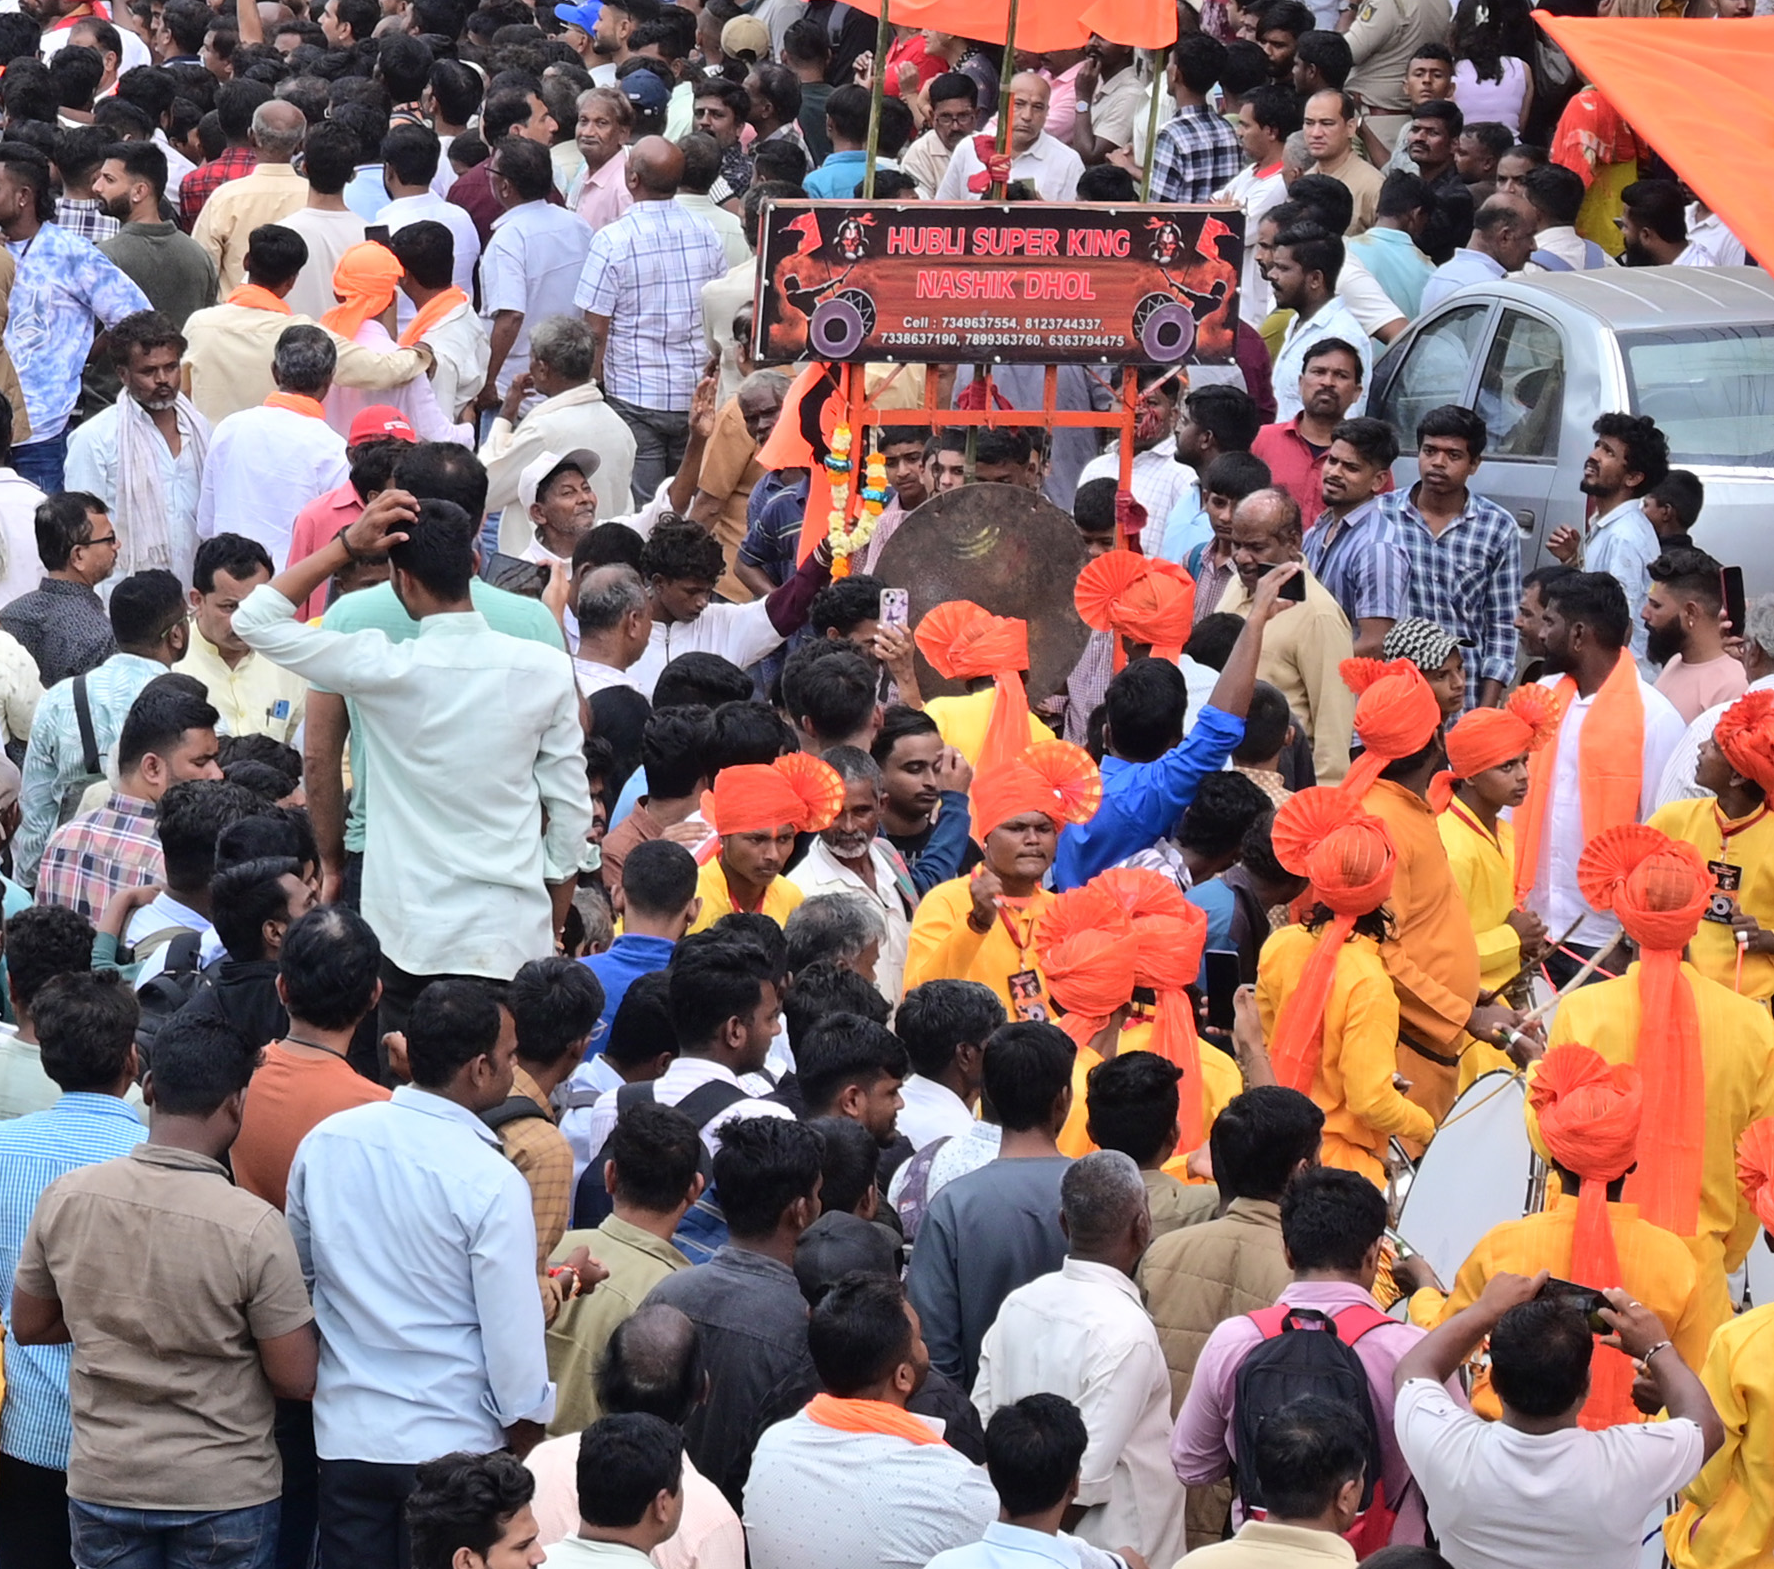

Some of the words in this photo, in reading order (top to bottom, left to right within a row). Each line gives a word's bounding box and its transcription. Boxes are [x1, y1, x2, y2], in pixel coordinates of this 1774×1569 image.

[887, 226, 965, 256] HUBLI
[972, 227, 1059, 258] SUPER
[1067, 229, 1130, 258] KING
[916, 270, 1017, 300] NASHIK
[1024, 271, 1096, 301] DHOL
[903, 316, 928, 329] Cell
[941, 317, 1021, 332] 7349637554,
[1025, 317, 1105, 333] 8123744337,
[880, 332, 961, 348] 7338637190,
[964, 333, 1046, 349] 7899363760,
[1049, 334, 1125, 348] 6363794475
